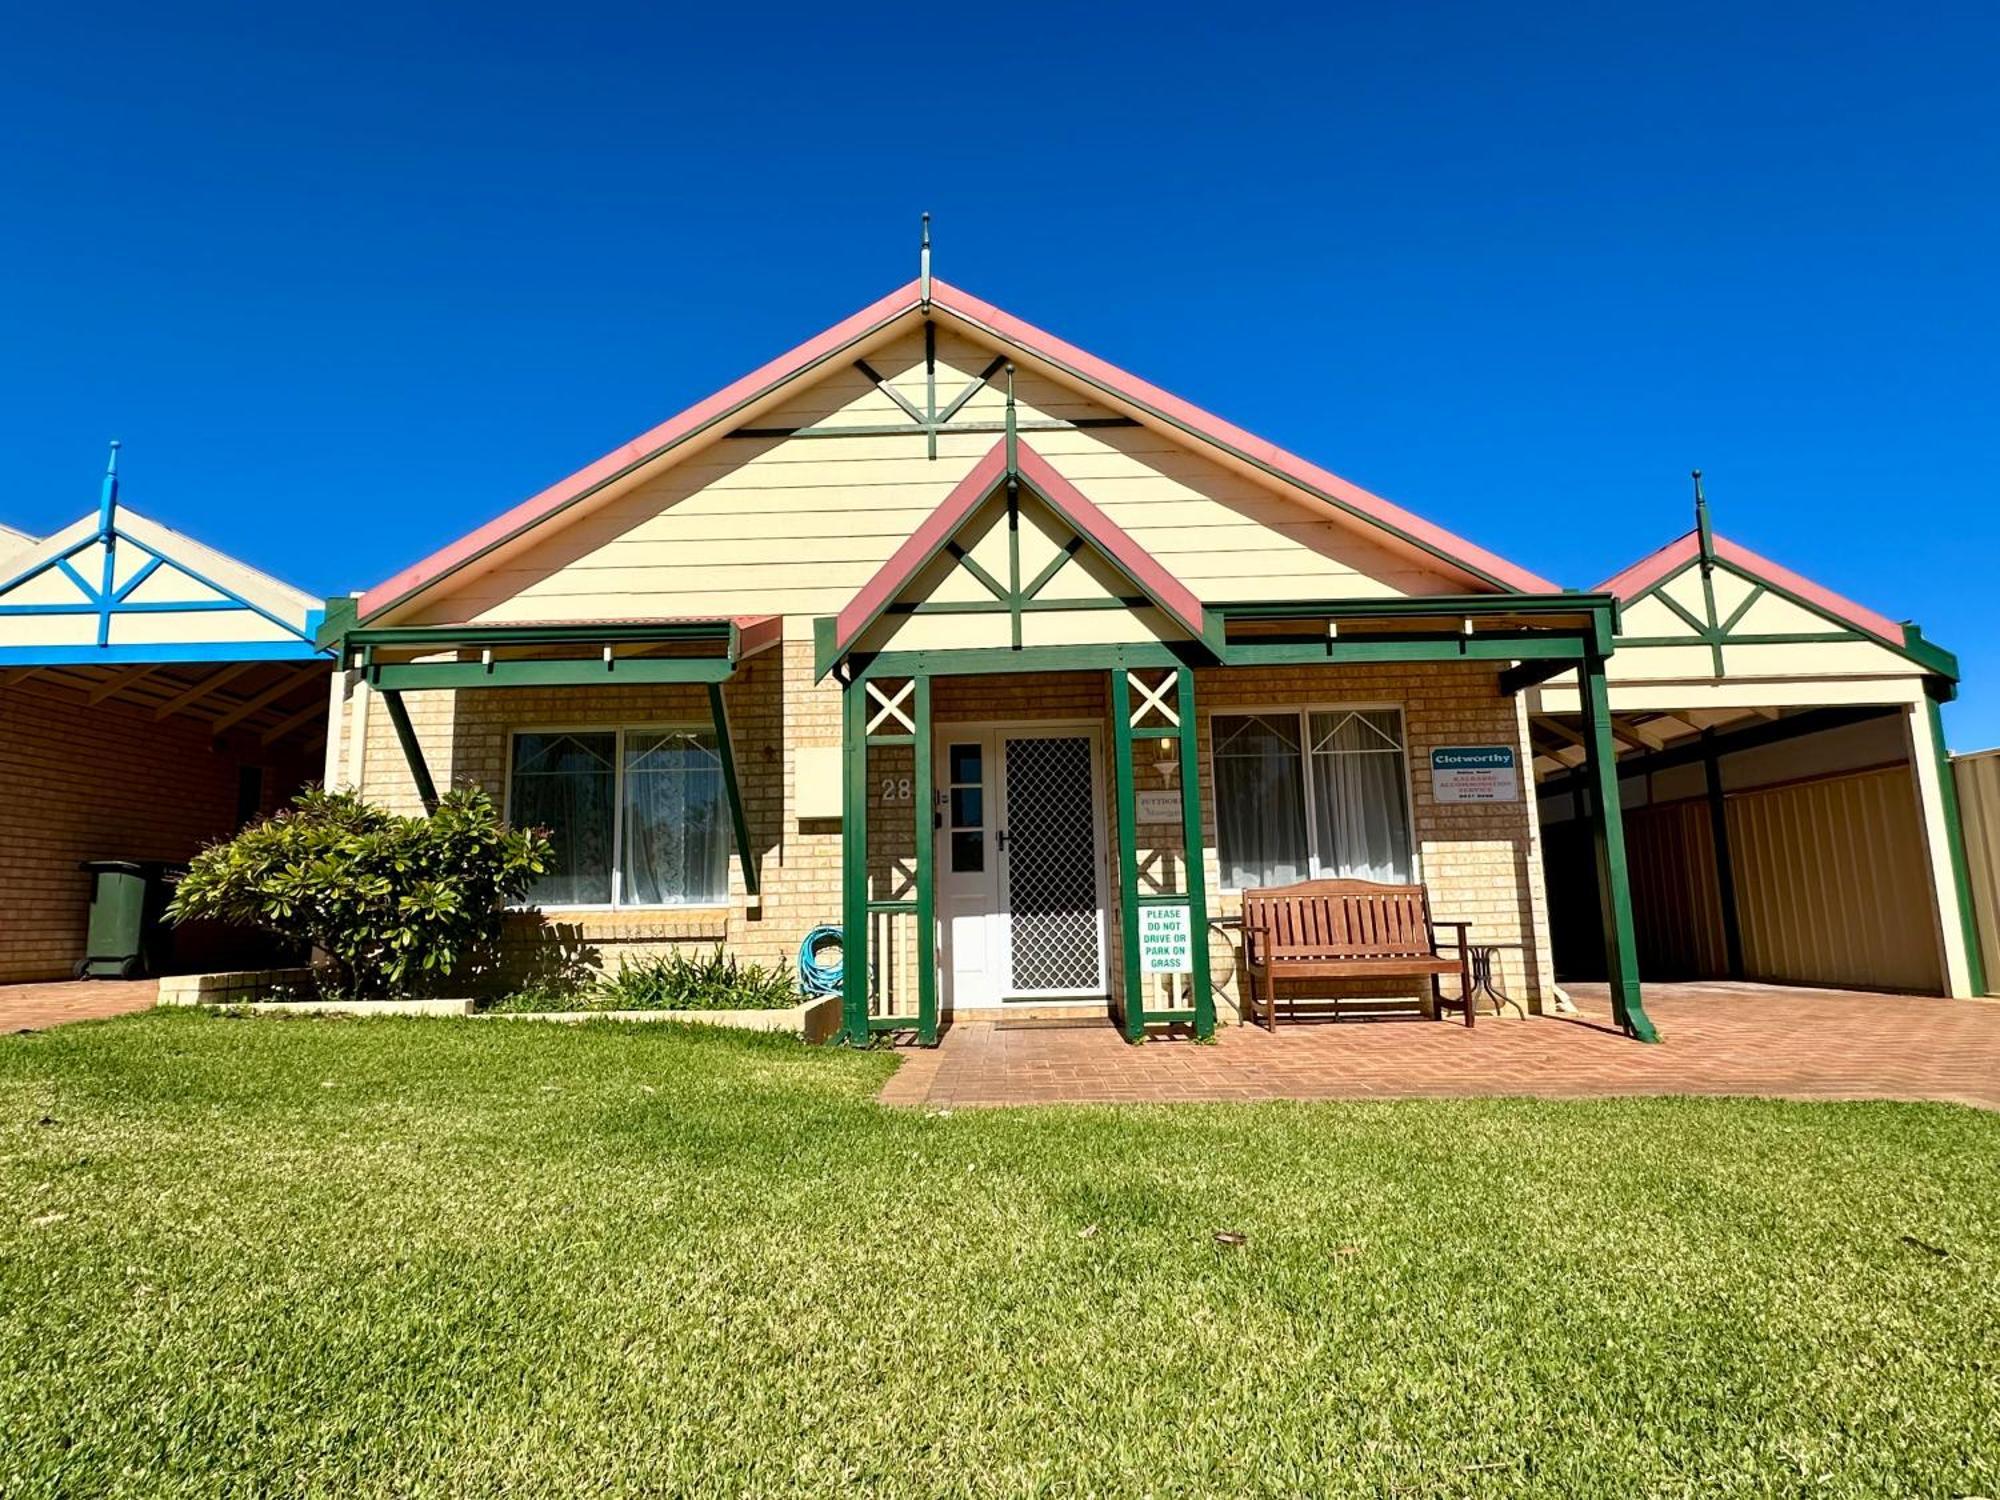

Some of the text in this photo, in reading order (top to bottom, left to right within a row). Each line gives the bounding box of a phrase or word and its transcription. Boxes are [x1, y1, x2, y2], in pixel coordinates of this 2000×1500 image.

[1435, 754, 1511, 764] Clotworthy
[881, 779, 911, 801] 28
[1147, 910, 1182, 919] PLEASE
[1147, 921, 1182, 931] DO NOT
[1143, 933, 1187, 944] DRIVE OR
[1145, 946, 1186, 956] PARK ON
[1151, 958, 1181, 968] GRASS
